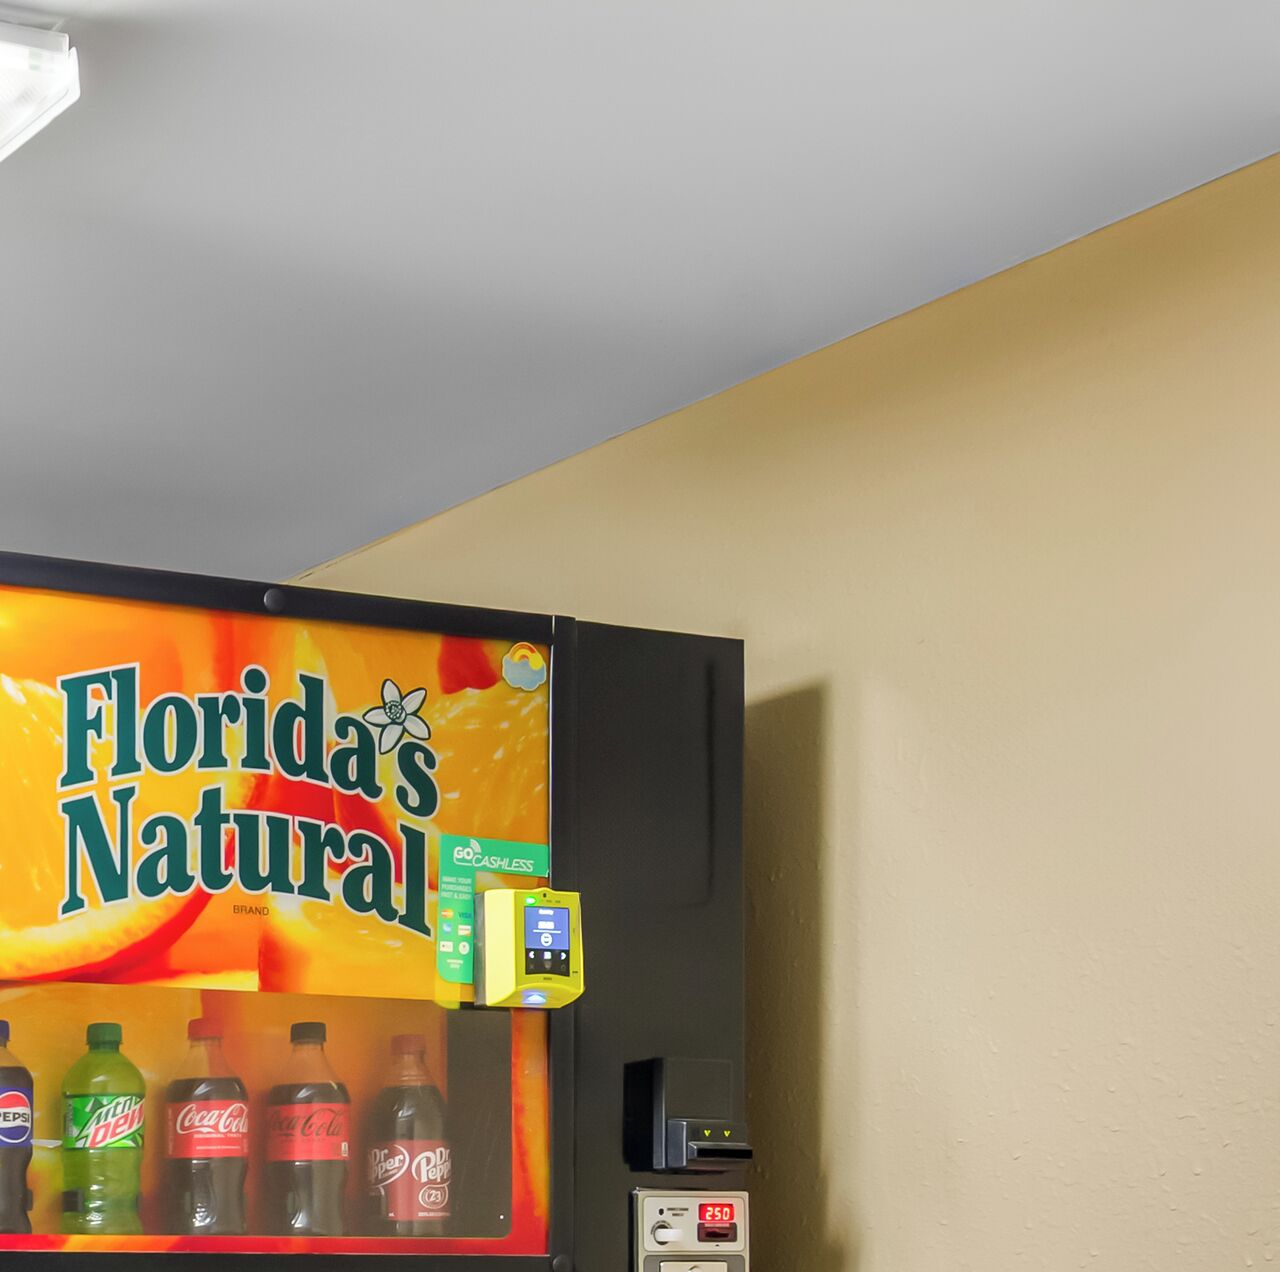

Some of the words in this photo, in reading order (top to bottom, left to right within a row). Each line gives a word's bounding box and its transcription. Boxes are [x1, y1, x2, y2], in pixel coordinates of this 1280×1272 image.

[57, 662, 439, 819] Florida's
[57, 785, 438, 939] Natural
[453, 846, 474, 860] GO
[472, 854, 534, 872] CASHLESS
[232, 904, 270, 918] BRAND
[435, 1147, 450, 1165] Dr
[429, 1189, 441, 1202] 23
